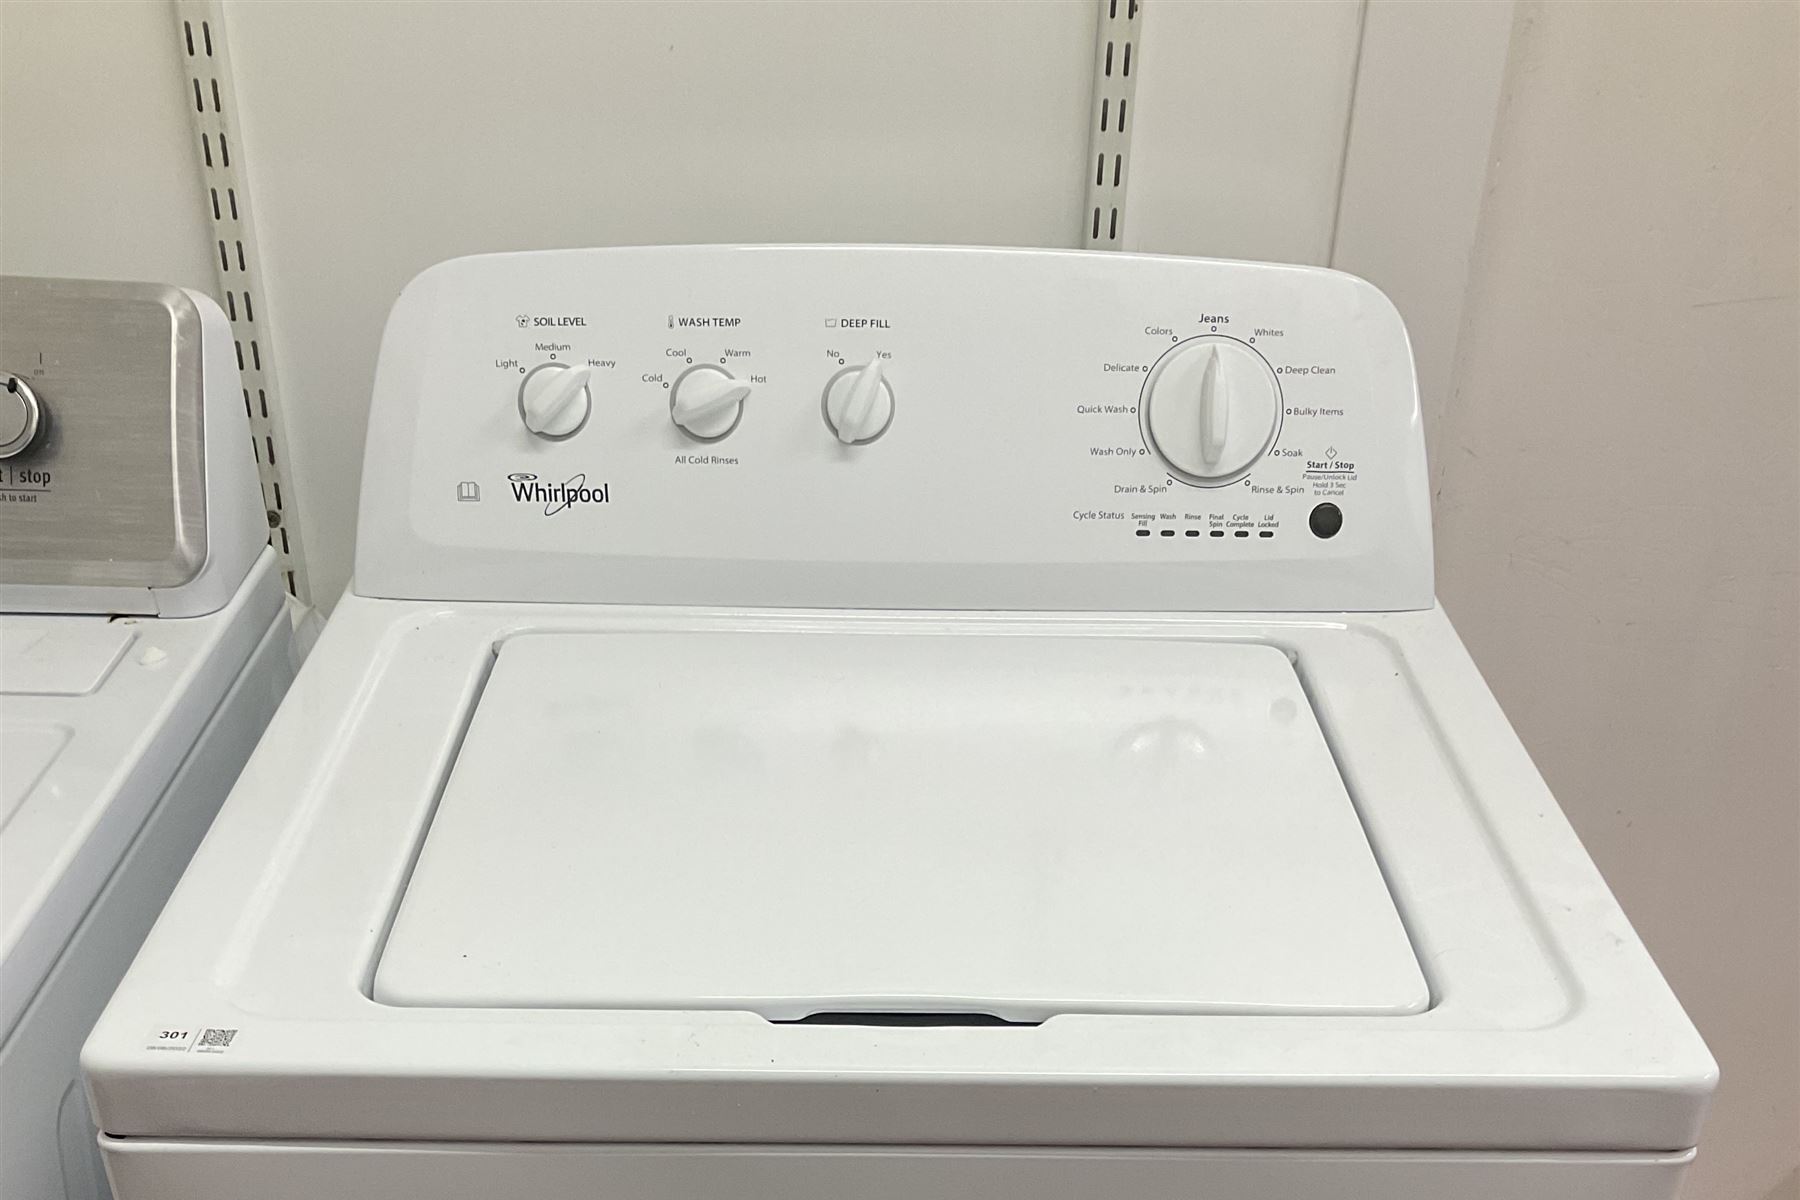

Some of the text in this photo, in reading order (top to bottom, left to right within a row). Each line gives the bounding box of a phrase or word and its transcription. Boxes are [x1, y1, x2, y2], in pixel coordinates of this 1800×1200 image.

[534, 317, 586, 326] SOIL LEVEL
[679, 317, 741, 327] WASH TEMP
[1198, 314, 1229, 323] Jeans
[841, 319, 890, 328] DEEP FILL
[1145, 327, 1172, 335] Colors
[1254, 328, 1284, 336] Whites
[535, 343, 570, 351] Medium
[666, 348, 686, 357] Cool
[725, 349, 751, 357] Warm
[827, 349, 839, 357] No
[876, 350, 892, 358] Yes
[495, 359, 518, 370] Light
[588, 359, 615, 369] Heavy
[1104, 364, 1139, 372] Delicate
[1285, 366, 1335, 376] Deep Clean
[642, 374, 662, 382] Cold
[751, 375, 766, 383] Hot
[1077, 405, 1128, 414] Quick Wash
[1294, 407, 1343, 417] Bulky Items
[1090, 447, 1136, 458] Wash Only
[1282, 449, 1303, 457] Soak
[675, 456, 738, 464] All Cold Rinses
[1307, 461, 1327, 469] Start
[1335, 461, 1354, 471] Stop
[20, 470, 51, 487] stop
[1114, 485, 1167, 495] Drain & Spin
[1252, 485, 1304, 496] Rinse & Spin
[9, 494, 16, 502] to
[19, 494, 37, 502] start
[512, 482, 609, 508] Whirlpool
[1073, 511, 1124, 521] Cycle Status
[1131, 513, 1155, 522] Sensing
[1233, 514, 1249, 522] Cycle
[1209, 521, 1223, 529] Spin
[1226, 521, 1254, 529] Complete
[159, 1031, 188, 1040] 301
